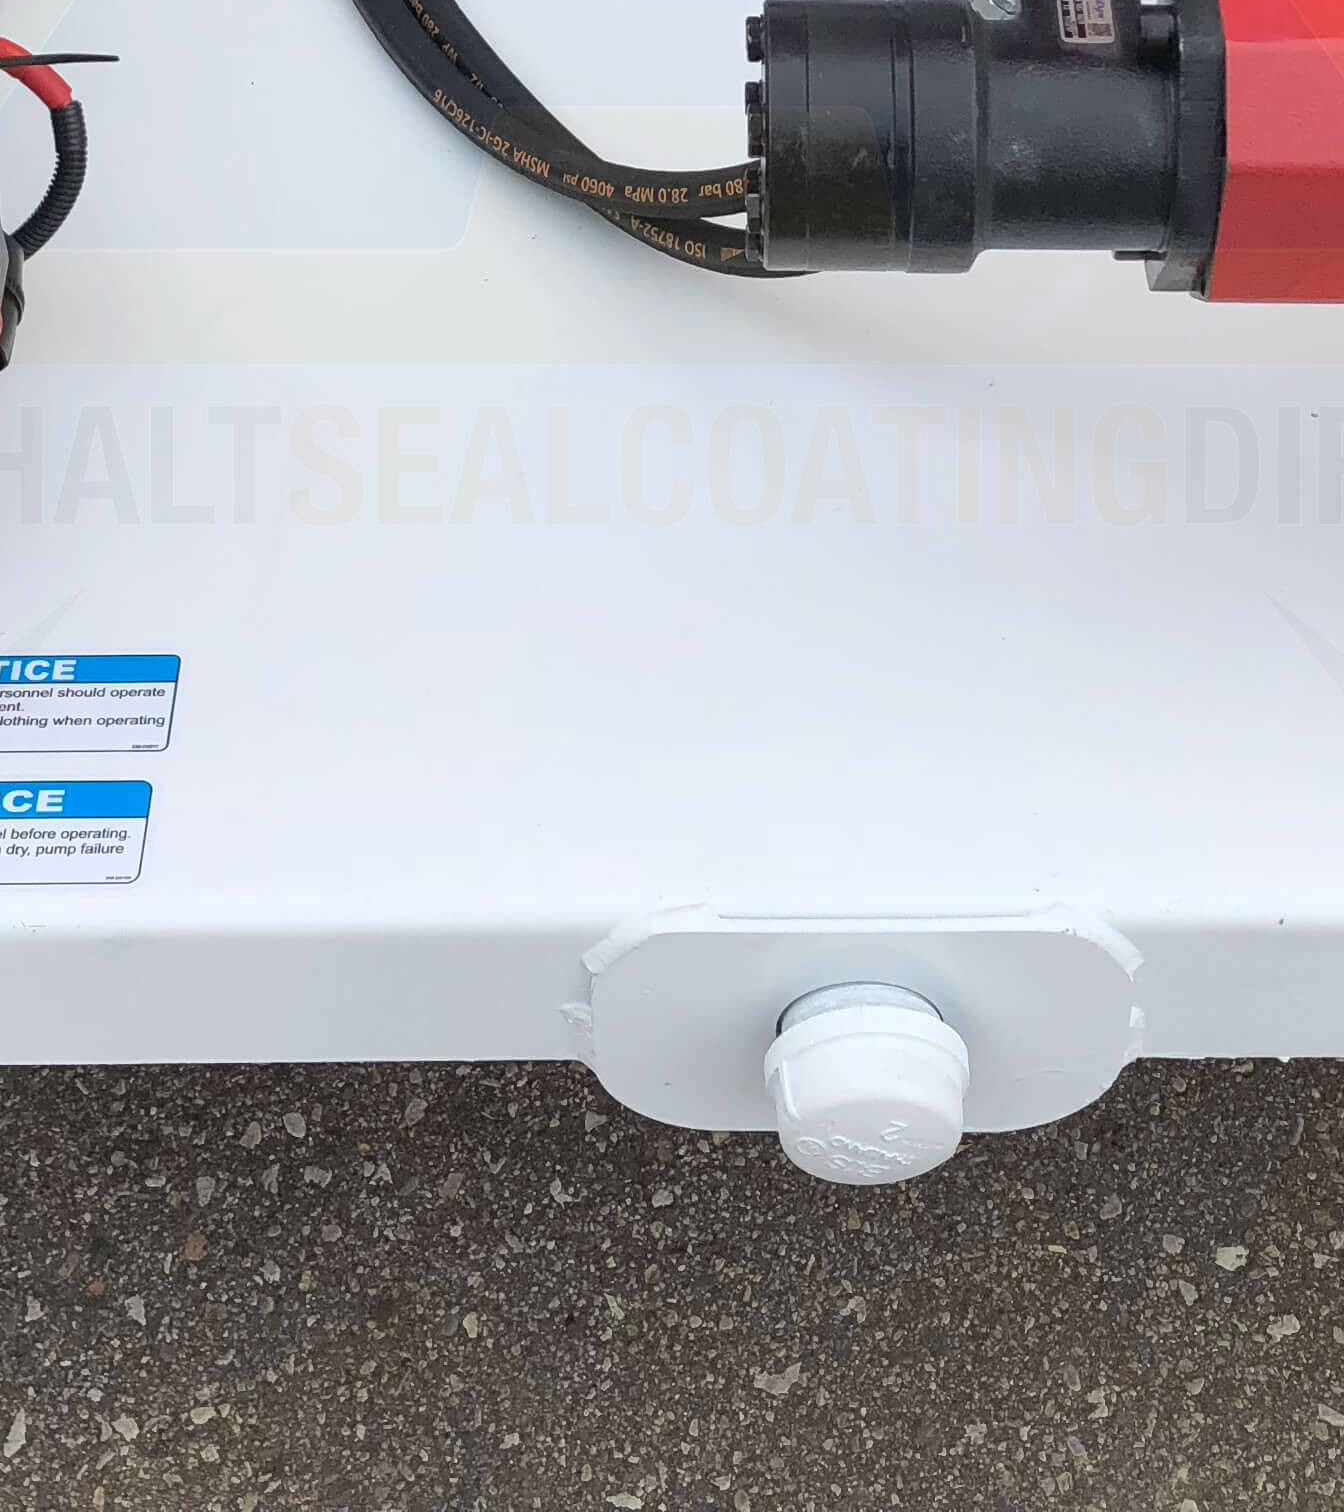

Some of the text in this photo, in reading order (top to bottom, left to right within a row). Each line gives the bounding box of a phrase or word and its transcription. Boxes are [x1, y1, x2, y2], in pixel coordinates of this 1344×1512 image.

[433, 88, 511, 152] 2G-IC-126C/16
[512, 146, 552, 178] MSHA
[562, 173, 579, 187] psi
[580, 177, 616, 198] 4060
[724, 178, 749, 196] 80
[623, 184, 654, 203] MPa
[657, 186, 689, 204] 28.0
[697, 181, 723, 198] bar
[629, 215, 707, 259] ISO 18752-A
[56, 686, 106, 698] should
[109, 687, 166, 699] operate
[52, 715, 93, 726] when
[96, 715, 165, 729] operating
[10, 828, 56, 840] before
[60, 828, 131, 843] operating.
[5, 843, 31, 858] dry,
[35, 844, 76, 858] pump
[80, 842, 124, 855] failure
